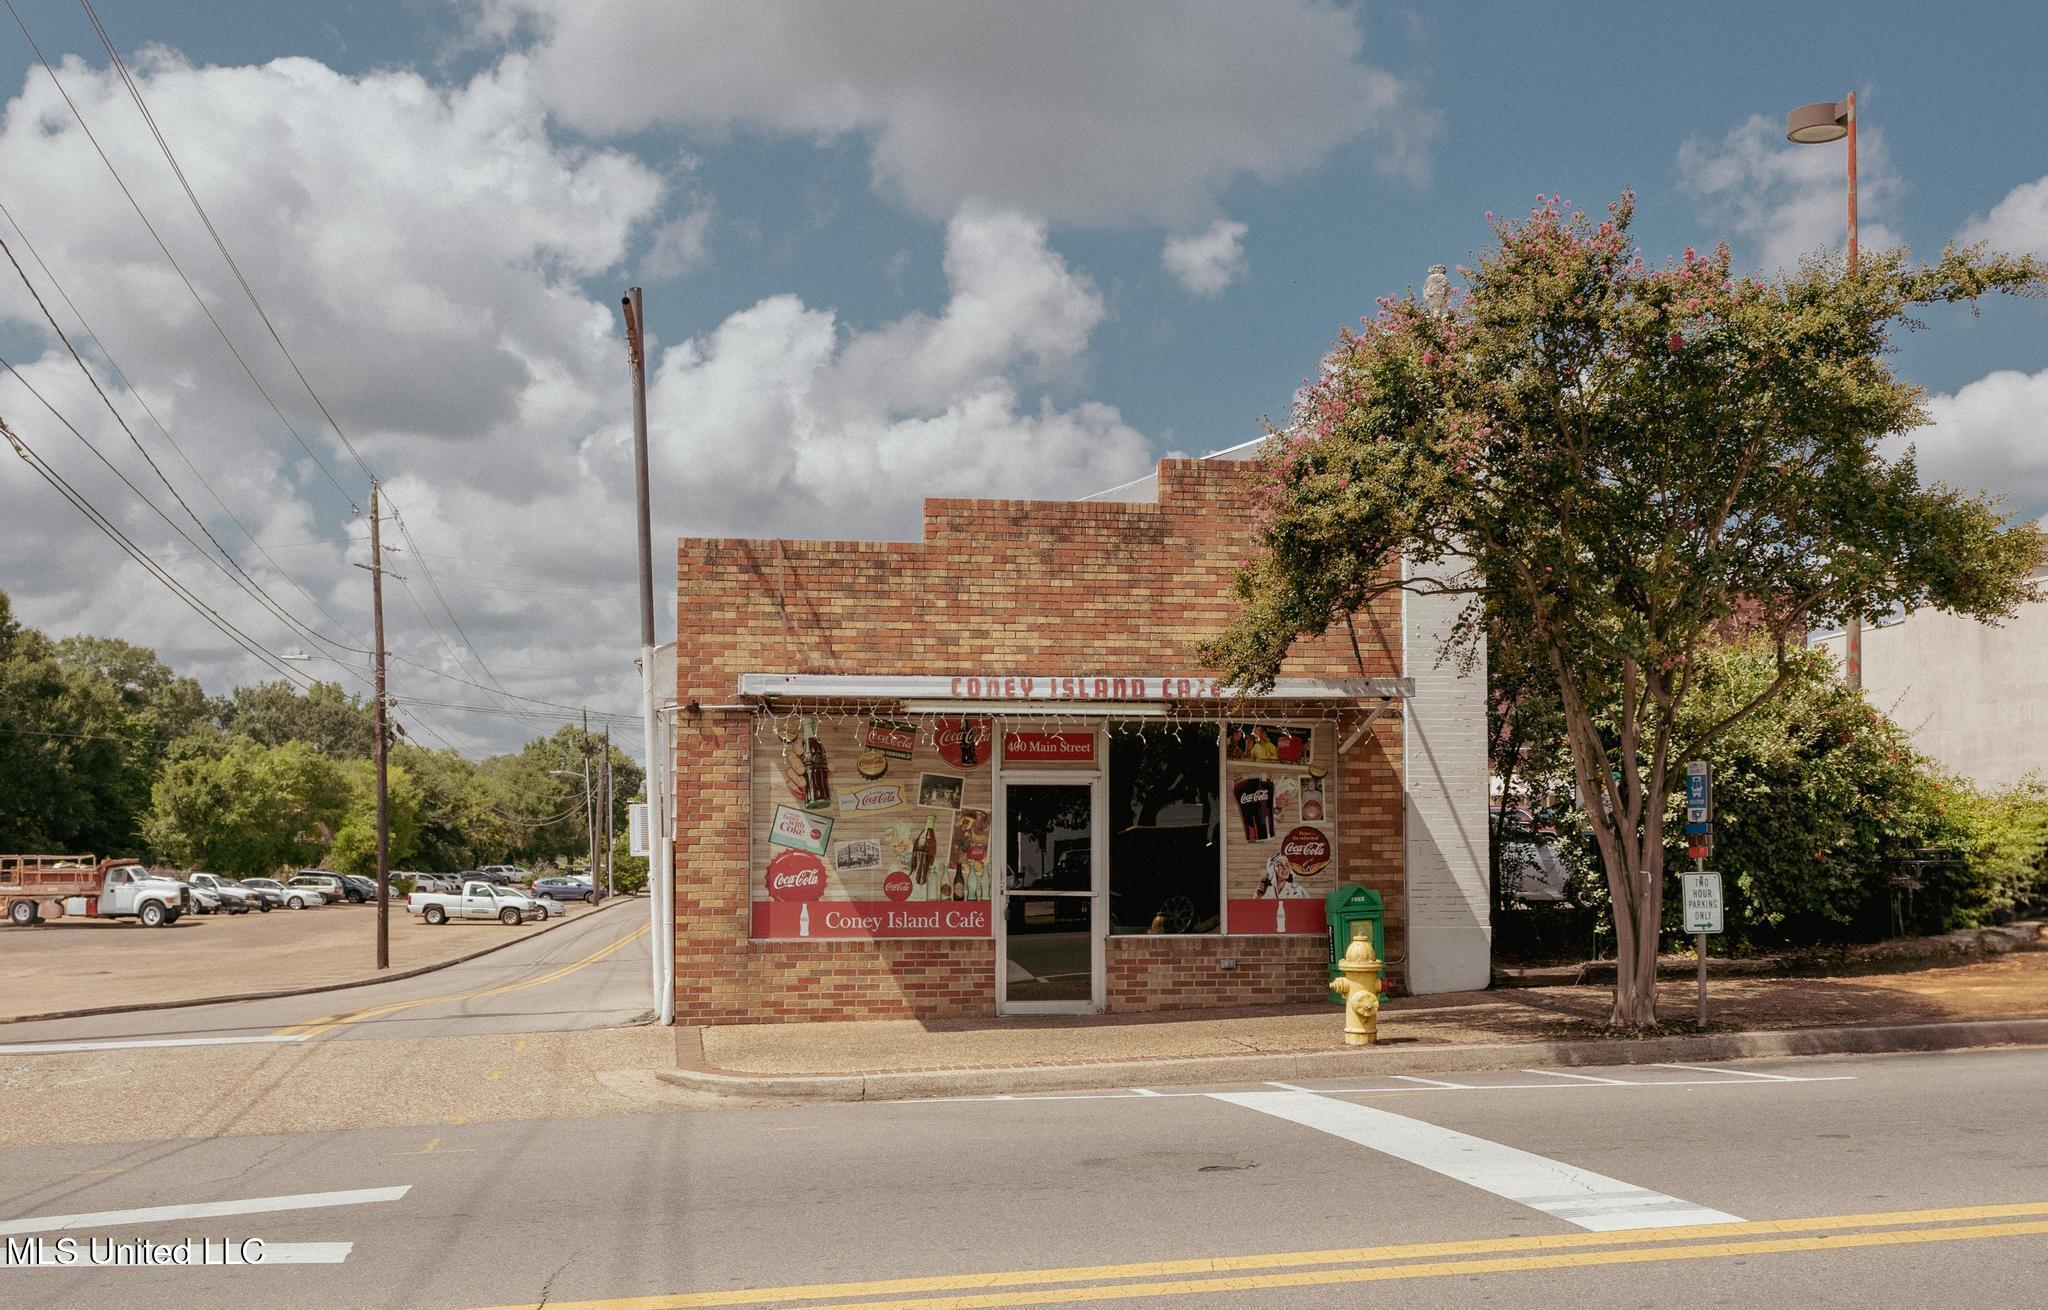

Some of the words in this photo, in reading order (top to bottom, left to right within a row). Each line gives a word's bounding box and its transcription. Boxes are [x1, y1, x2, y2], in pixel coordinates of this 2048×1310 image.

[951, 677, 1033, 698] CONEY
[1051, 678, 1145, 698] ISLAND
[1008, 741, 1027, 752] 400
[1029, 741, 1057, 752] Main
[1060, 741, 1092, 752] Street
[1240, 789, 1269, 804] Coca-Cola
[780, 821, 805, 836] Coke
[1284, 841, 1327, 856] Coca-Cola
[773, 869, 819, 890] Coca-Cola
[1695, 878, 1708, 888] TWO
[1693, 889, 1712, 899] HOUR
[1688, 900, 1718, 909] PARKING
[825, 911, 883, 932] Coney
[887, 911, 940, 928] Island
[945, 910, 985, 928] Café
[1695, 911, 1712, 921] ONLY
